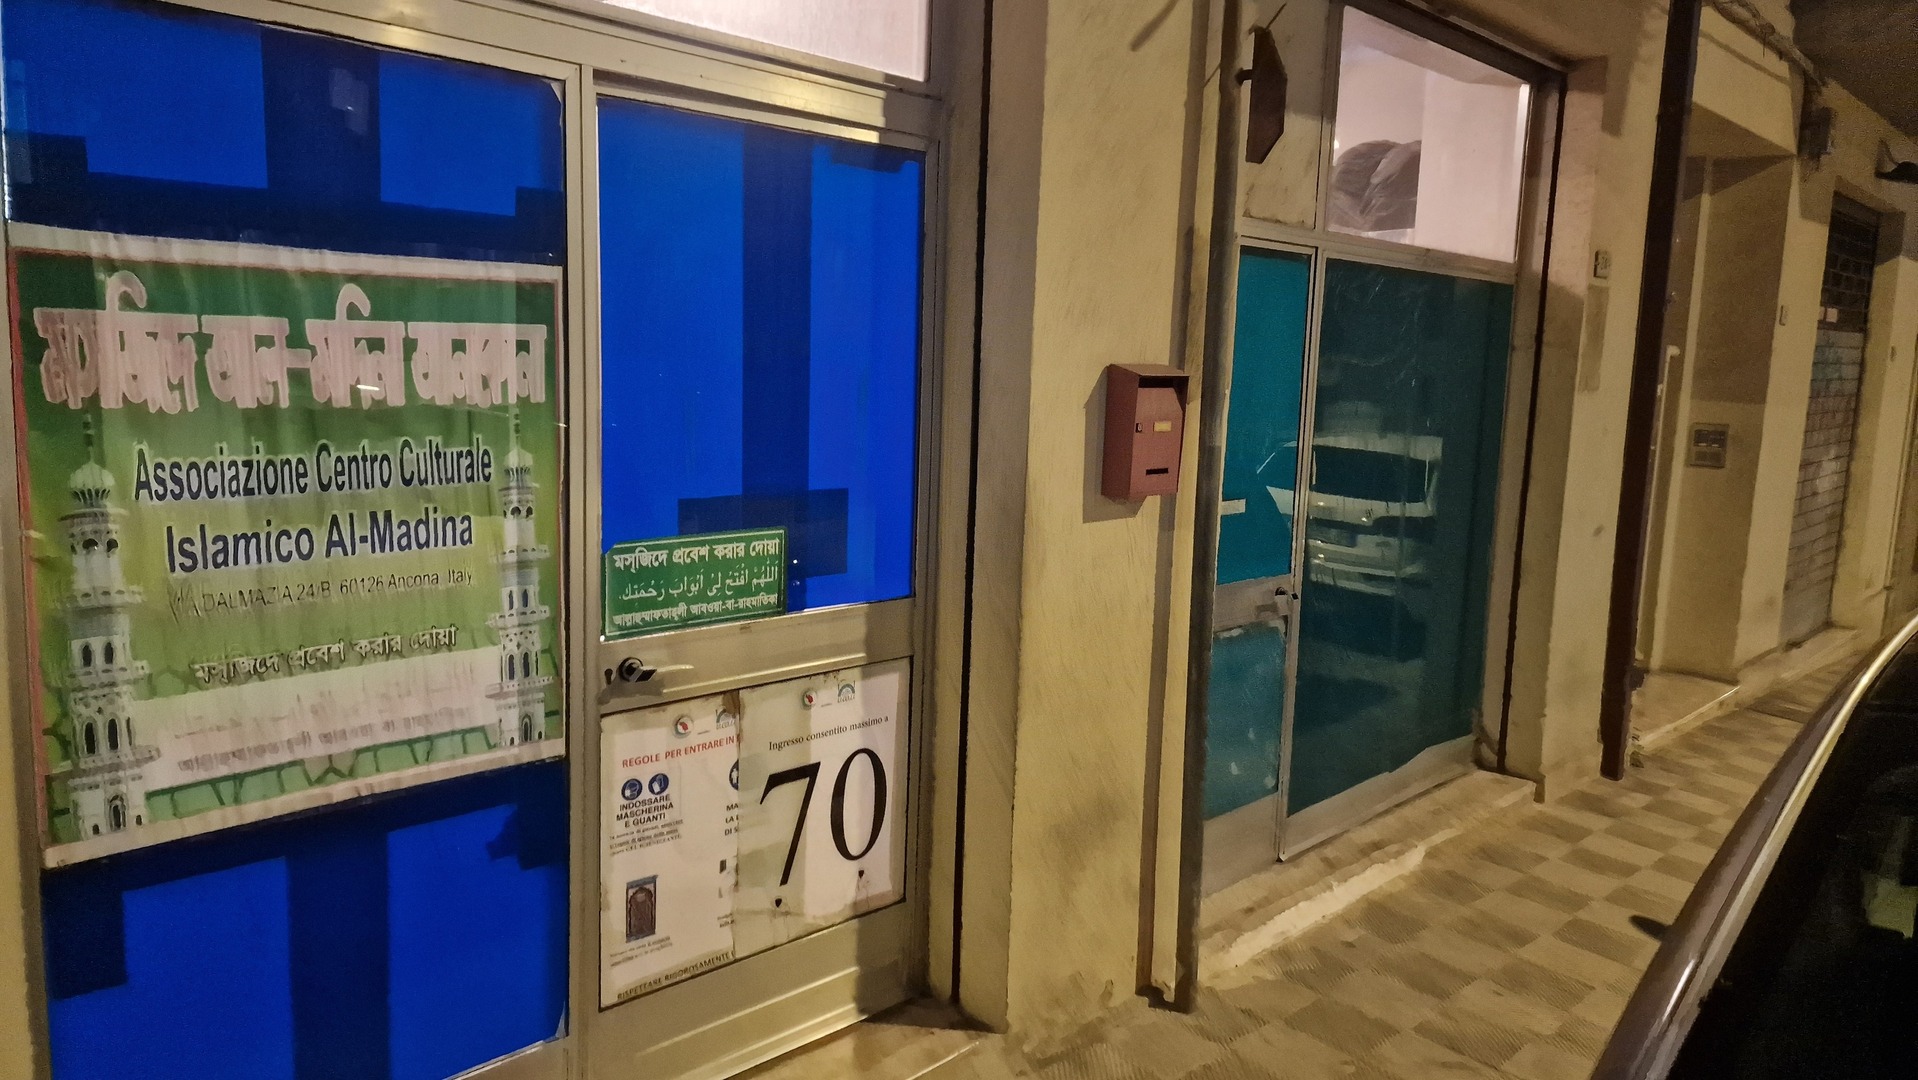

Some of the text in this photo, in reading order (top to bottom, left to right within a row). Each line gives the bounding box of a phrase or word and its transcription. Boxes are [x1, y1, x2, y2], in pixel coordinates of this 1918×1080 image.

[134, 437, 492, 501] Associazione Centro Culturale
[166, 505, 473, 573] Islamico Al-Madina
[672, 544, 709, 565] প্রবেশ
[713, 541, 746, 560] করার
[750, 538, 780, 557] দোয়া
[202, 585, 293, 613] DALMAZIA
[340, 575, 383, 595] 60126
[448, 569, 472, 586] Italy
[352, 632, 402, 657] করার
[769, 736, 804, 752] Ingresso
[806, 725, 847, 741] consentito
[849, 717, 883, 731] massimo
[622, 752, 660, 768] REGOLE
[664, 748, 682, 760] PER
[684, 739, 724, 755] ENTRARE
[725, 735, 735, 745] IN
[616, 802, 674, 821] MASCHERINA
[619, 794, 671, 812] INDOSSARE
[632, 812, 666, 827] GUANTI
[760, 748, 887, 887] 70
